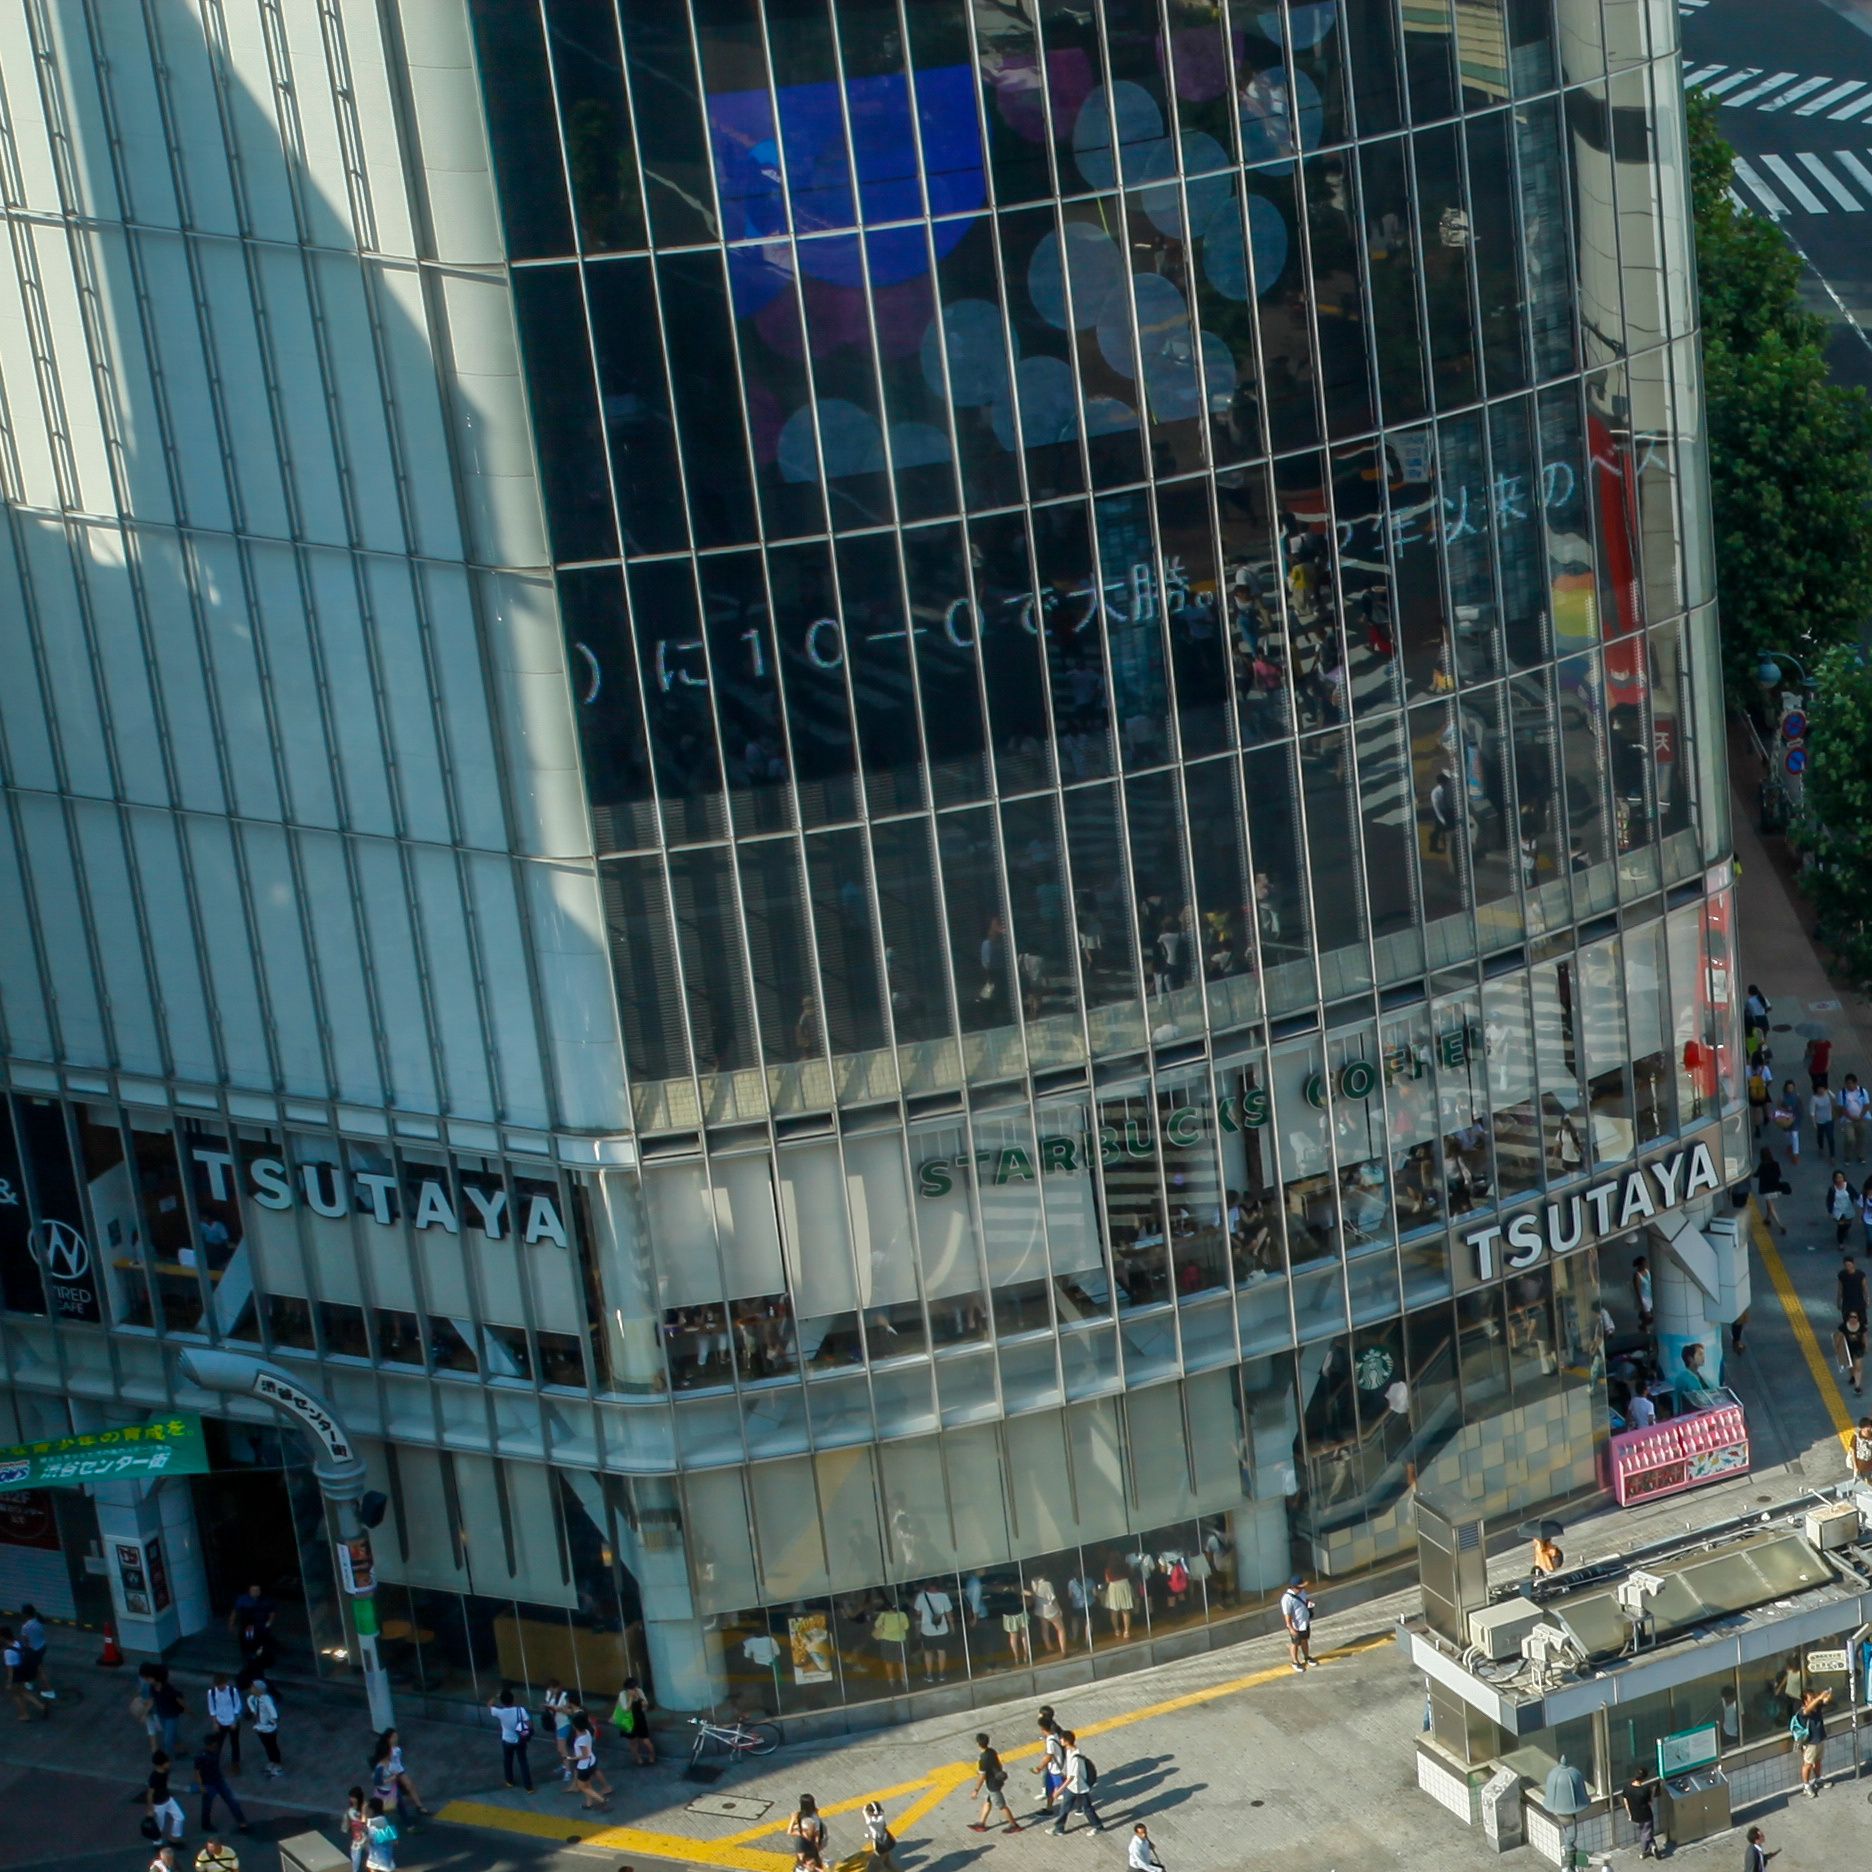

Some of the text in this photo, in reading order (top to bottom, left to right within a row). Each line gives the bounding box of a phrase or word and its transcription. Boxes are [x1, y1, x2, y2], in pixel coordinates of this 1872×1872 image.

[191, 1149, 569, 1251] TSUTAYA
[1467, 1142, 1721, 1280] TSUTAYA
[54, 1286, 92, 1302] IRED
[258, 1377, 349, 1460] 渋谷センター街
[40, 1452, 171, 1480] 渋谷センター街
